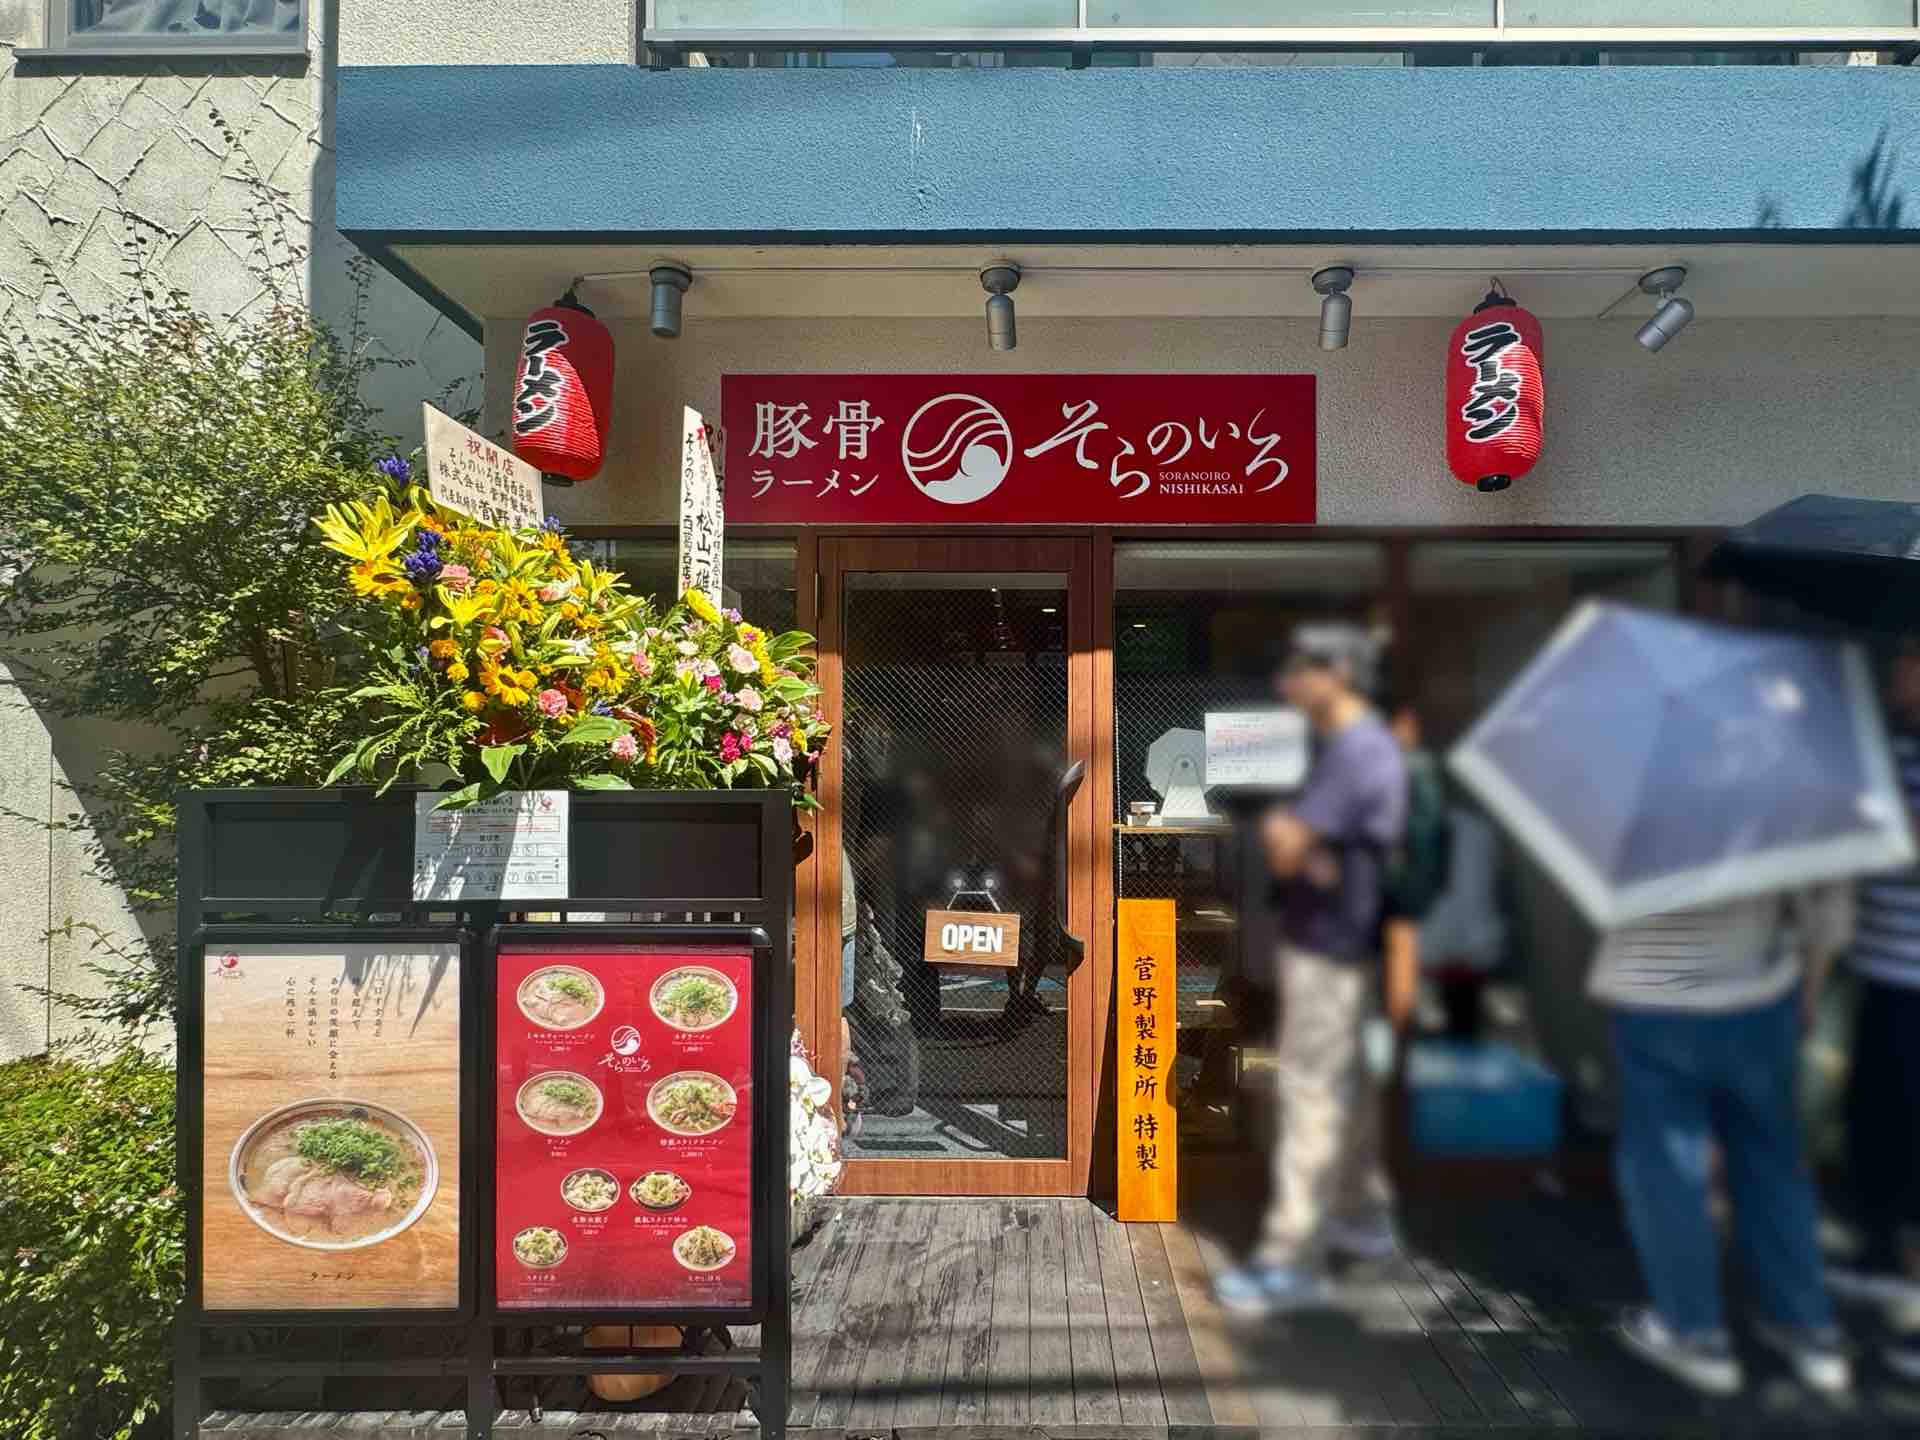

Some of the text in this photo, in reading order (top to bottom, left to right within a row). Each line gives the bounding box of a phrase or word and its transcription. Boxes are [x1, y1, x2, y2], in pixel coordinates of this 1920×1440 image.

[512, 320, 568, 435] ラーメン
[1462, 322, 1523, 444] ラーメン
[748, 399, 884, 460] 豚骨
[1024, 398, 1289, 499] そらのいろ
[466, 434, 515, 477] 祝開店
[1158, 471, 1231, 481] SORANOIRO
[750, 469, 880, 499] ラーメン
[1158, 483, 1245, 495] NISHIKASAI
[940, 922, 1004, 953] OPEN
[597, 1051, 652, 1073] そらのいろ
[1132, 956, 1160, 1172] 菅野製麺所 特製
